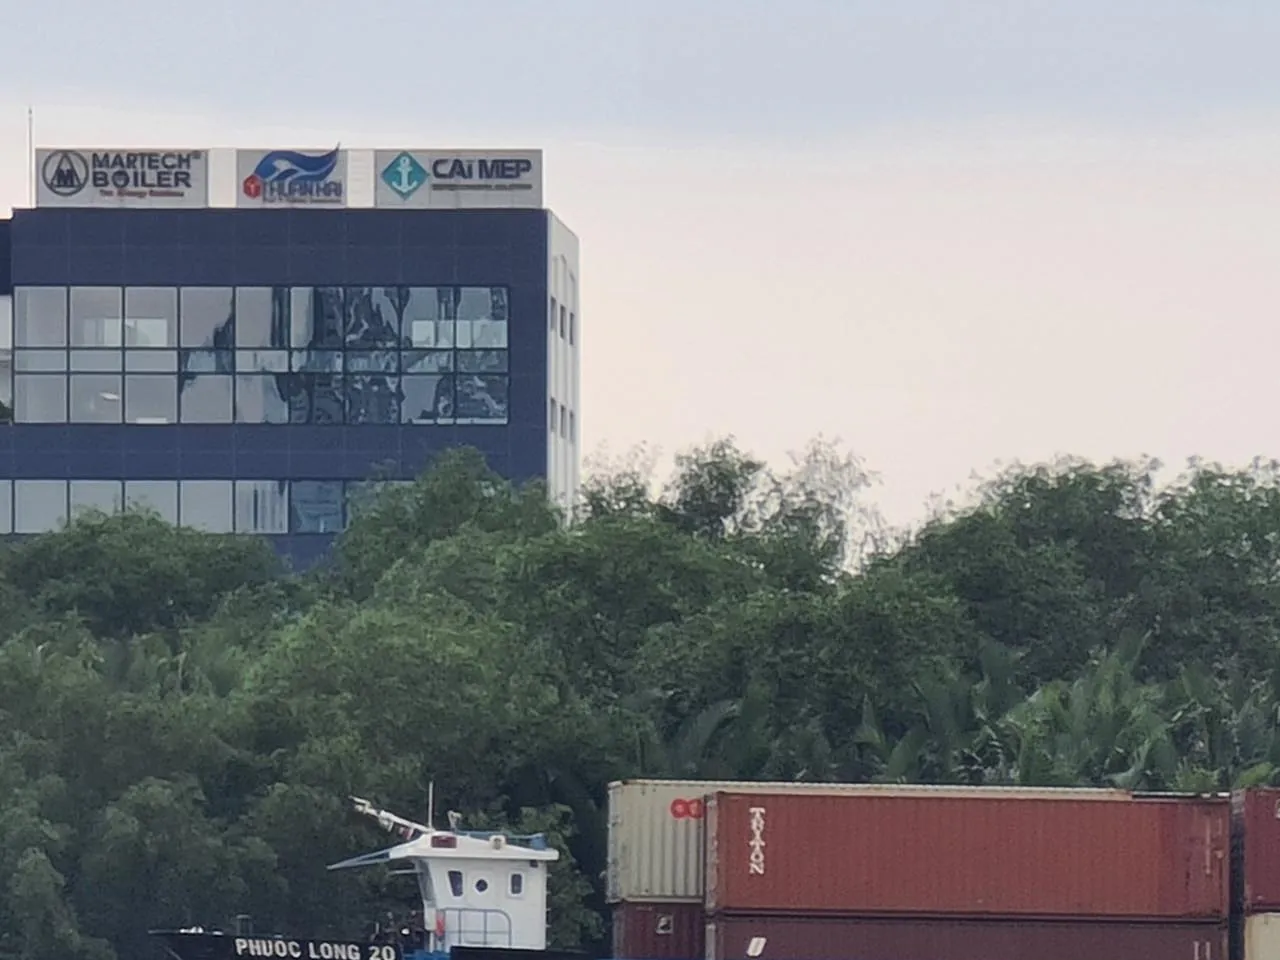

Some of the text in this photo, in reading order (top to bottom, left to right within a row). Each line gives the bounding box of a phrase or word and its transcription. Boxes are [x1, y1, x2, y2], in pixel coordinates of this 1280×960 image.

[92, 152, 191, 169] MARTECH
[478, 158, 532, 179] MEP
[92, 171, 192, 188] BOILER
[749, 807, 766, 875] TRITON
[308, 942, 361, 960] LONG
